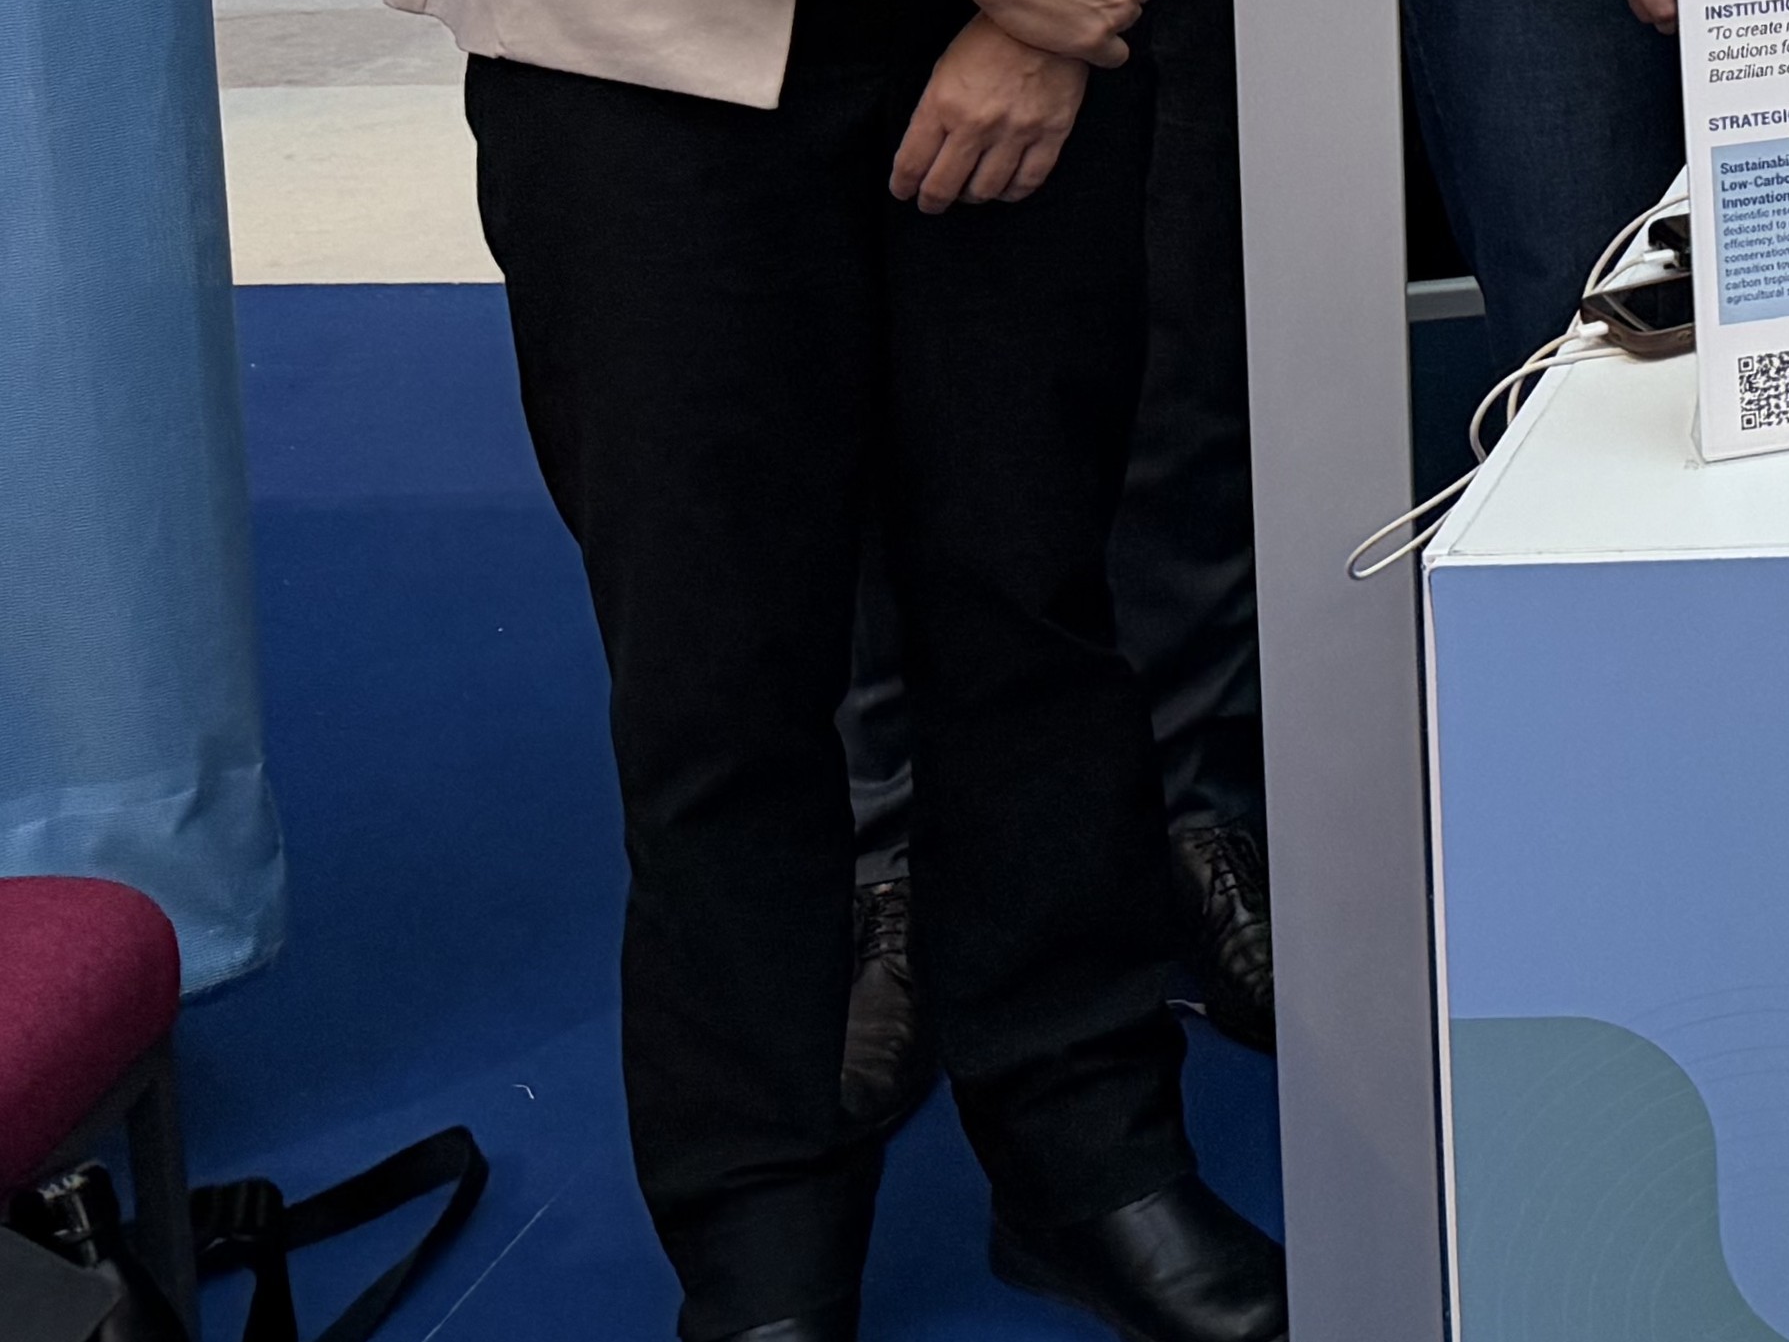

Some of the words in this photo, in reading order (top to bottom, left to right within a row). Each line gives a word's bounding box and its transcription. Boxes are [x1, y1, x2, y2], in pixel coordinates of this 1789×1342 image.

[1736, 22, 1782, 39] create
[1708, 40, 1777, 62] solutions
[1709, 63, 1774, 83] Brazilian
